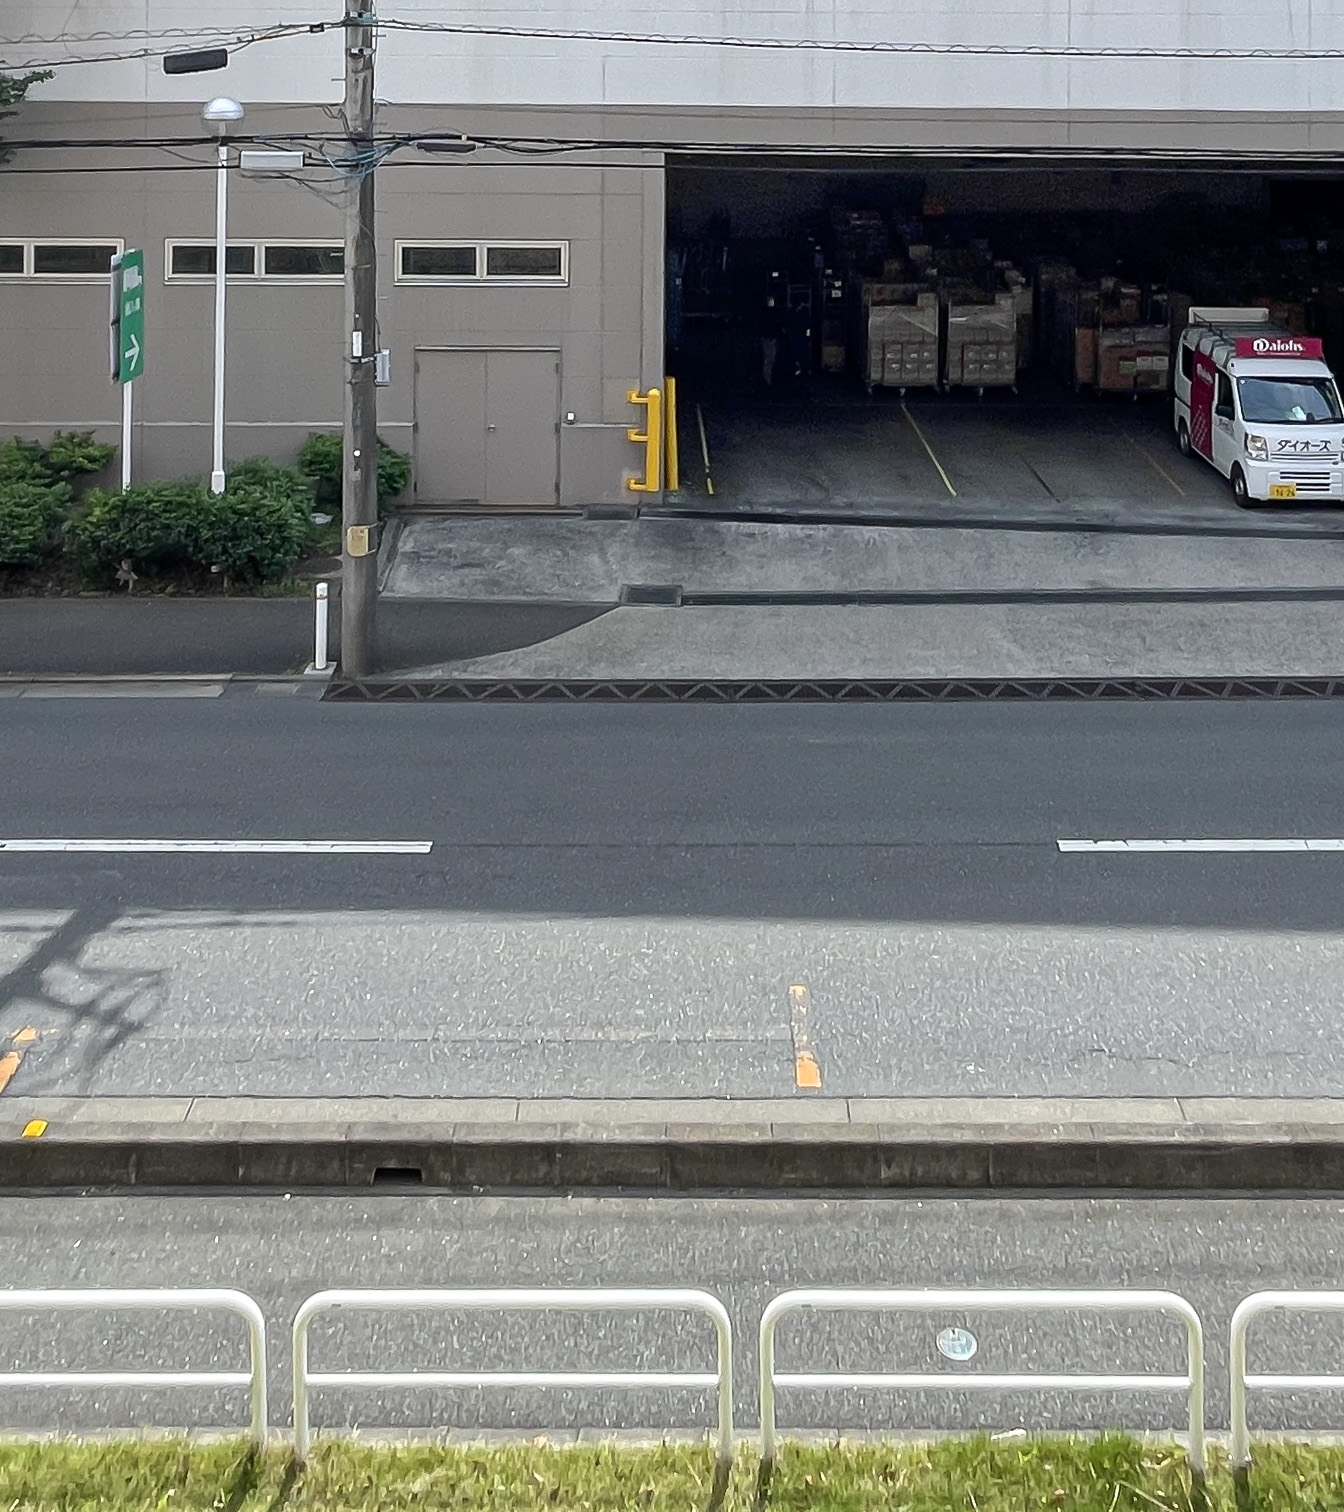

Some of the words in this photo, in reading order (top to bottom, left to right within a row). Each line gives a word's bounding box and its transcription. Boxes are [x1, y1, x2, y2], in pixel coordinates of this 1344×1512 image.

[1277, 439, 1332, 452] ダイオーズ
